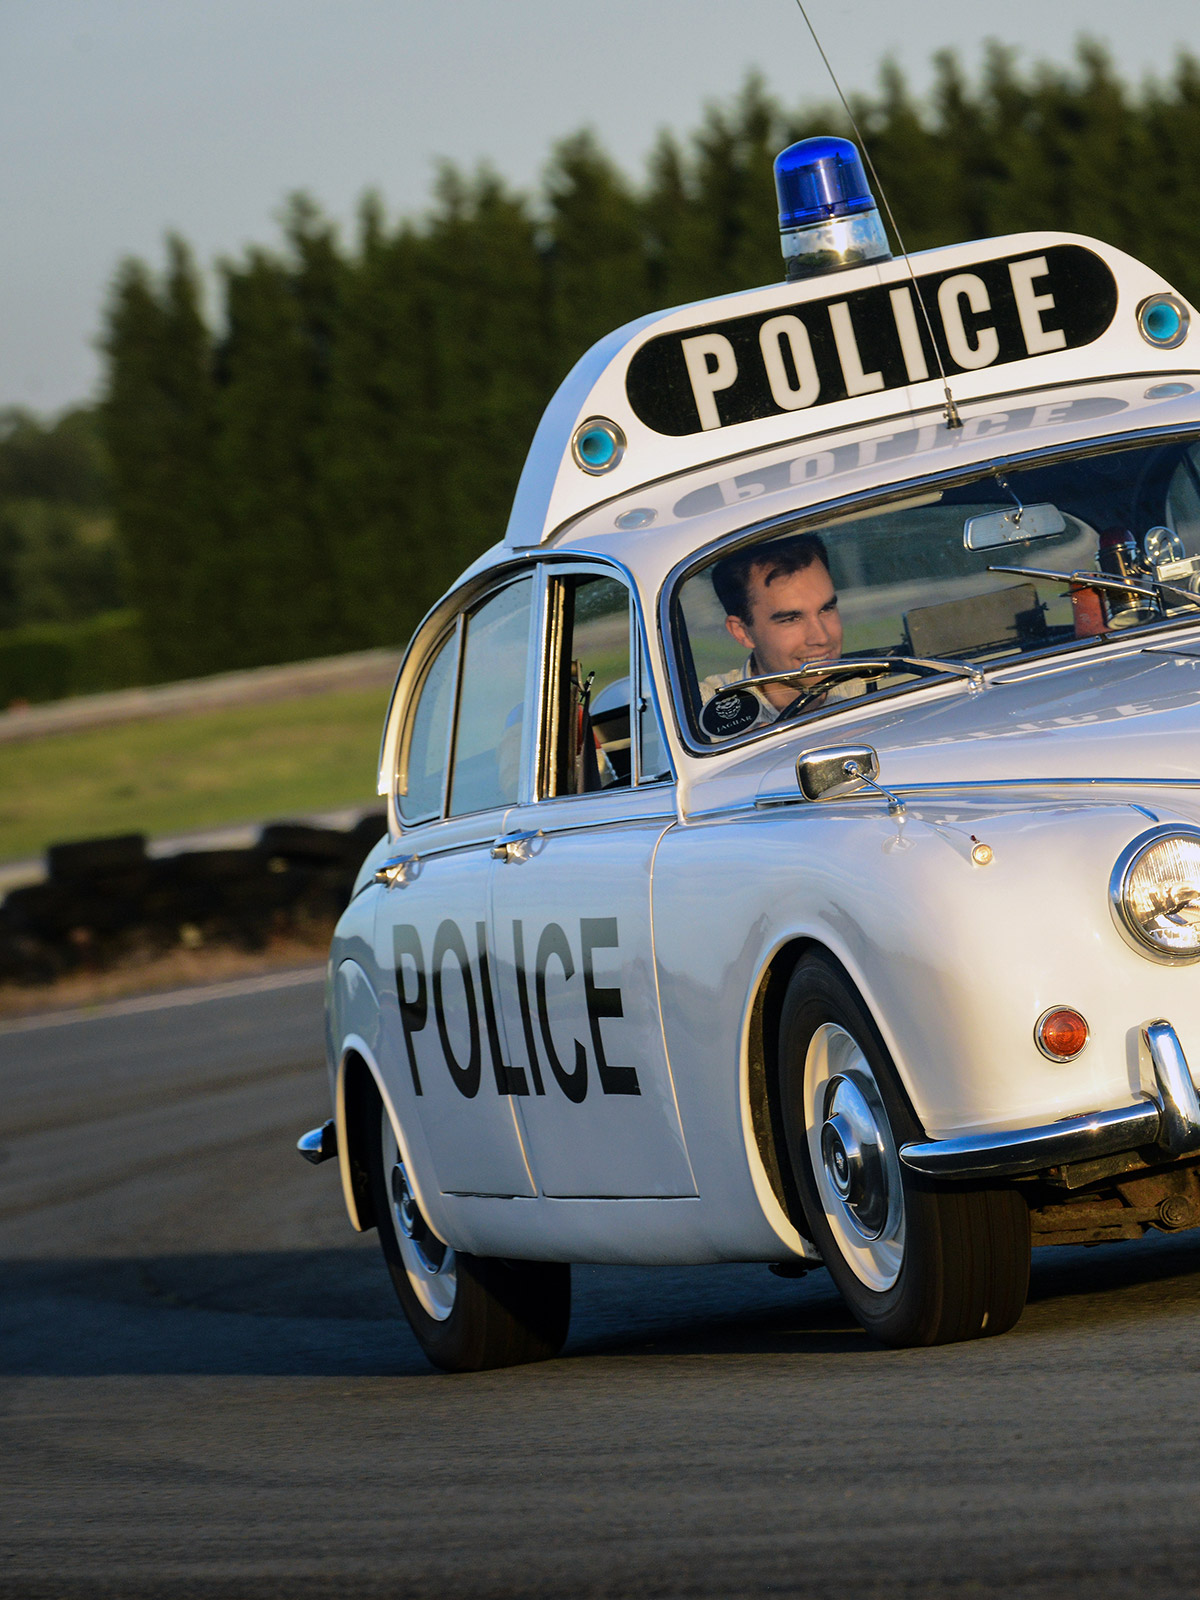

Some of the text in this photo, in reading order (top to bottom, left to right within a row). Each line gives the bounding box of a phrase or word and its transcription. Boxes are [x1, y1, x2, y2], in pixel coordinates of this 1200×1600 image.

[681, 256, 1067, 431] POLICE
[716, 715, 752, 733] JAGUAR
[393, 917, 641, 1103] POLICE
